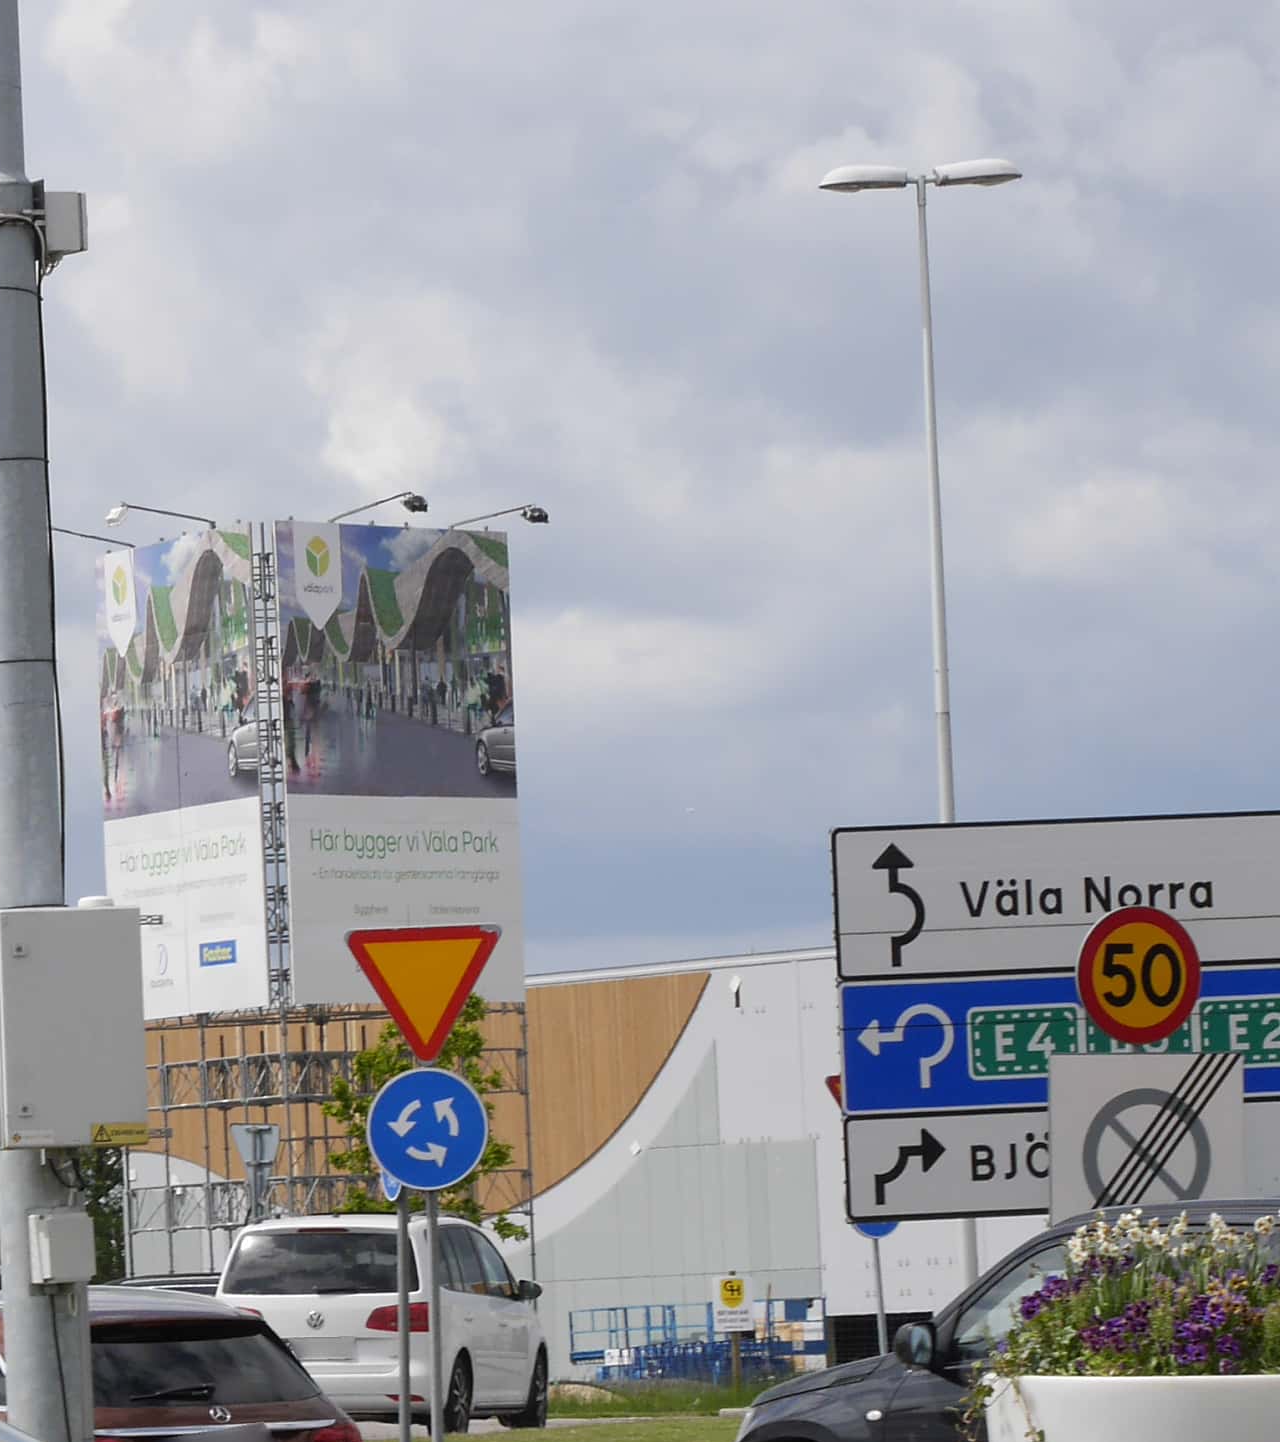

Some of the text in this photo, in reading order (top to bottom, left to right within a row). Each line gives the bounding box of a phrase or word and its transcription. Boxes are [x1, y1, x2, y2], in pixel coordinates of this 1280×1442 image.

[309, 828, 498, 859] Här bygger vi Väla Park
[959, 876, 1214, 918] Väla Norra
[1102, 943, 1182, 1008] 50
[970, 1132, 1050, 1182] BJÖ
